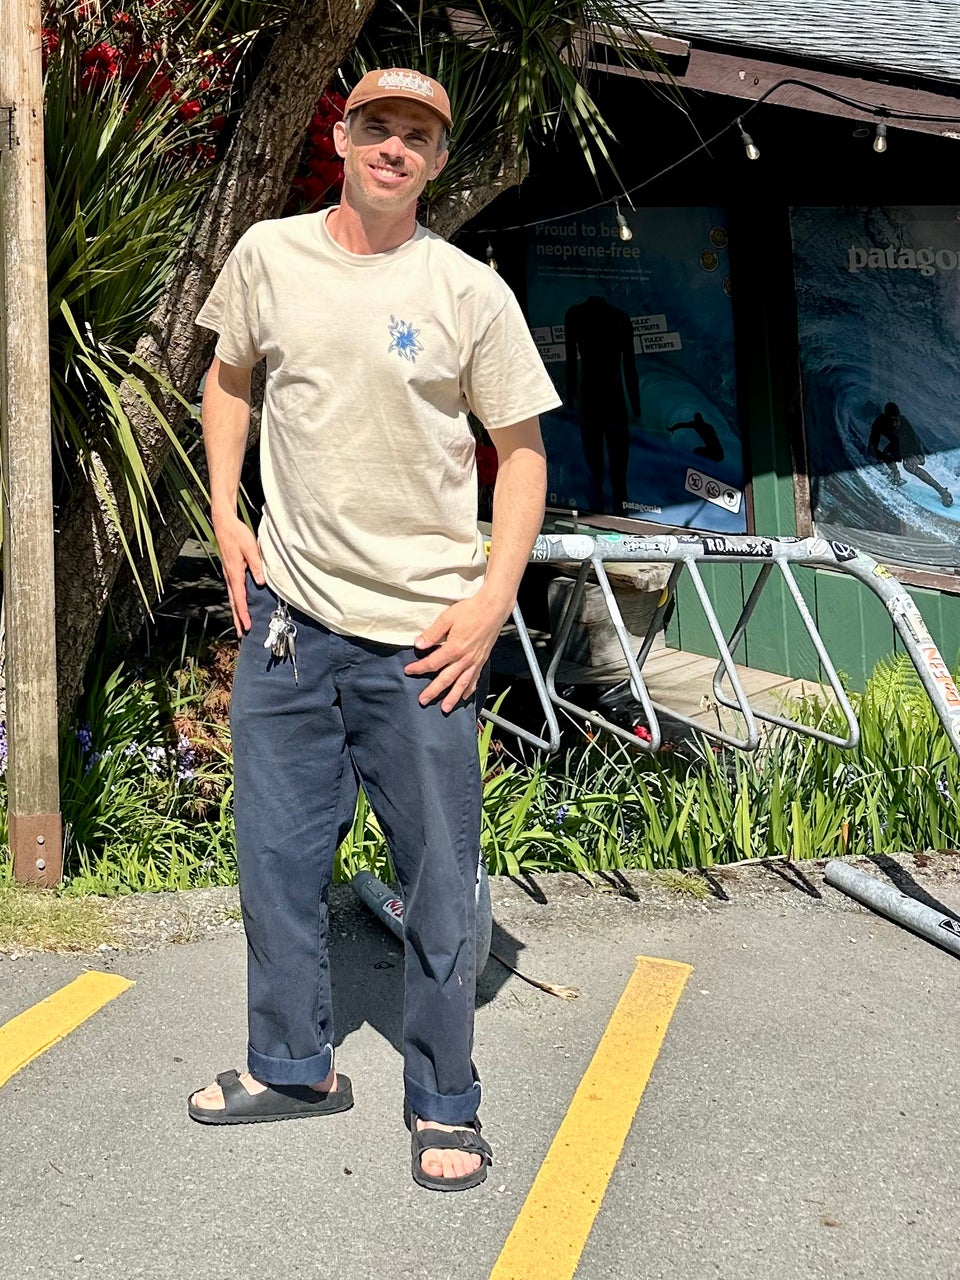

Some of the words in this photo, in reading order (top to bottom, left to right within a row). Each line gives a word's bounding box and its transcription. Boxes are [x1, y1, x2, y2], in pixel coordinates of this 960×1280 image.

[535, 221, 577, 236] Proud
[581, 223, 597, 237] to
[600, 222, 620, 237] be
[536, 242, 641, 260] neoprene-free
[622, 501, 662, 514] patagonia
